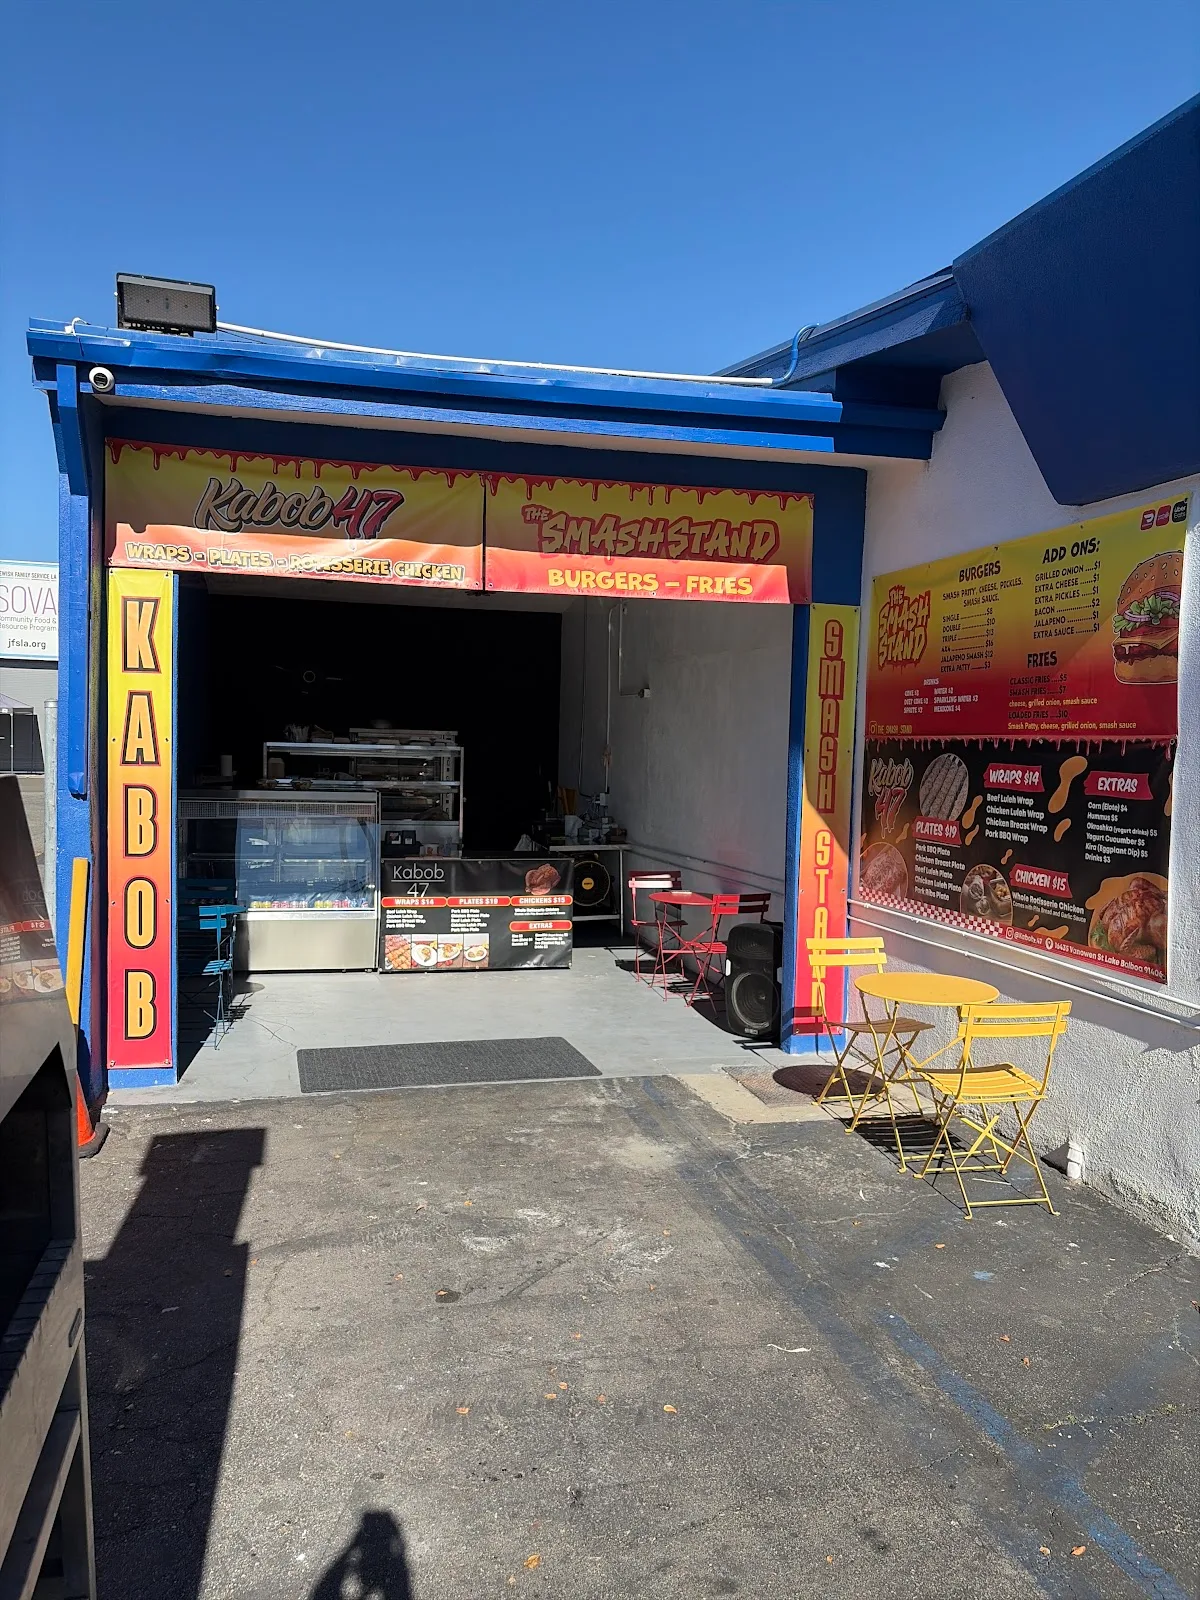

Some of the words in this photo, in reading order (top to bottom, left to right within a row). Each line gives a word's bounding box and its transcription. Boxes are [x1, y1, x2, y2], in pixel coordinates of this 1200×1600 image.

[522, 505, 552, 523] THE
[1042, 546, 1066, 564] ADD
[1070, 537, 1100, 560] ONS:
[125, 542, 192, 562] WRAPS
[208, 548, 275, 569] PLATES
[289, 554, 391, 576] ROTISSERIE
[393, 561, 465, 582] CHICKEN
[959, 560, 1000, 582] BURGERS
[1035, 570, 1060, 582] GRILLED
[1061, 565, 1084, 577] ONION
[547, 568, 659, 592] BURGERS
[686, 575, 753, 595] FRIES
[1035, 583, 1054, 594] EXTRA
[1055, 578, 1078, 590] CHEESE
[0, 584, 57, 615] SOVA
[889, 586, 904, 606] THE
[942, 590, 960, 600] SMASH
[963, 597, 981, 608] SMASH
[1034, 594, 1054, 604] EXTRA
[1055, 589, 1080, 602] PICKLES
[879, 593, 930, 638] SMASH
[942, 613, 959, 622] SINGLE
[1034, 606, 1055, 616] BACON
[34, 616, 50, 624] Food
[1034, 616, 1066, 628] JALAPENO
[29, 624, 57, 632] Program
[942, 624, 961, 633] DOUBLE
[1033, 629, 1052, 639] EXTRA
[1053, 626, 1074, 637] SAUCE
[7, 638, 46, 650] jfsla.org
[942, 634, 957, 642] TRIPLE
[879, 626, 927, 669] STAND
[966, 652, 984, 660] SMASH
[1027, 650, 1057, 668] FRIES
[940, 665, 955, 673] EXTRA
[1009, 675, 1034, 685] CLASSIC
[1034, 674, 1050, 684] FRIES
[1009, 688, 1029, 696] SMASH
[1029, 687, 1046, 695] FRIES
[1028, 698, 1045, 708] grilled
[1062, 697, 1080, 705] smash
[1080, 697, 1097, 705] sauce
[817, 619, 845, 813] SMASH
[1008, 710, 1032, 719] LOADED
[1033, 710, 1048, 718] FRIES
[1007, 722, 1024, 730] Smash
[1060, 721, 1079, 731] grilled
[1098, 721, 1118, 729] smash
[868, 758, 914, 796] Kabob
[989, 768, 1022, 784] WRAPS
[1024, 769, 1039, 786] $14
[1097, 777, 1138, 793] EXTRAS
[986, 793, 1000, 802] Beef
[1017, 796, 1034, 807] Wrap
[1087, 802, 1101, 810] Corn
[1101, 803, 1120, 812] (Elote)
[1120, 803, 1128, 812] $4
[120, 596, 163, 1040] KABOB
[986, 805, 1009, 816] Chicken
[1027, 809, 1044, 820] Wrap
[1087, 812, 1110, 822] Hummus
[1111, 814, 1118, 822] $5
[915, 821, 943, 836] PLATES
[944, 824, 957, 838] $19
[985, 817, 1009, 828] Chicken
[1010, 820, 1030, 830] Breast
[1031, 822, 1048, 834] Wrap
[1149, 828, 1157, 837] $5
[985, 829, 999, 839] Pork
[999, 831, 1011, 841] BBQ
[1012, 832, 1029, 844] Wrap
[1086, 832, 1105, 843] Yogurt
[1105, 835, 1137, 846] Cucumber
[1137, 838, 1145, 846] $5
[1084, 853, 1103, 862] Drinks
[1103, 855, 1111, 864] $3
[1097, 844, 1126, 856] (Eggplant
[1127, 847, 1140, 858] Dip)
[1140, 850, 1148, 858] $5
[915, 854, 934, 864] Chicken
[392, 863, 444, 880] Kabob
[1014, 869, 1050, 888] CHICKEN
[1052, 875, 1066, 892] $15
[407, 882, 430, 898] 47
[1011, 891, 1030, 902] Whole
[1029, 894, 1058, 908] Rotisserie
[1058, 900, 1084, 915] Chicken
[1069, 945, 1097, 959] Vanowen
[1097, 952, 1104, 961] St
[1104, 954, 1120, 965] Lake
[1120, 959, 1143, 973] Balboa
